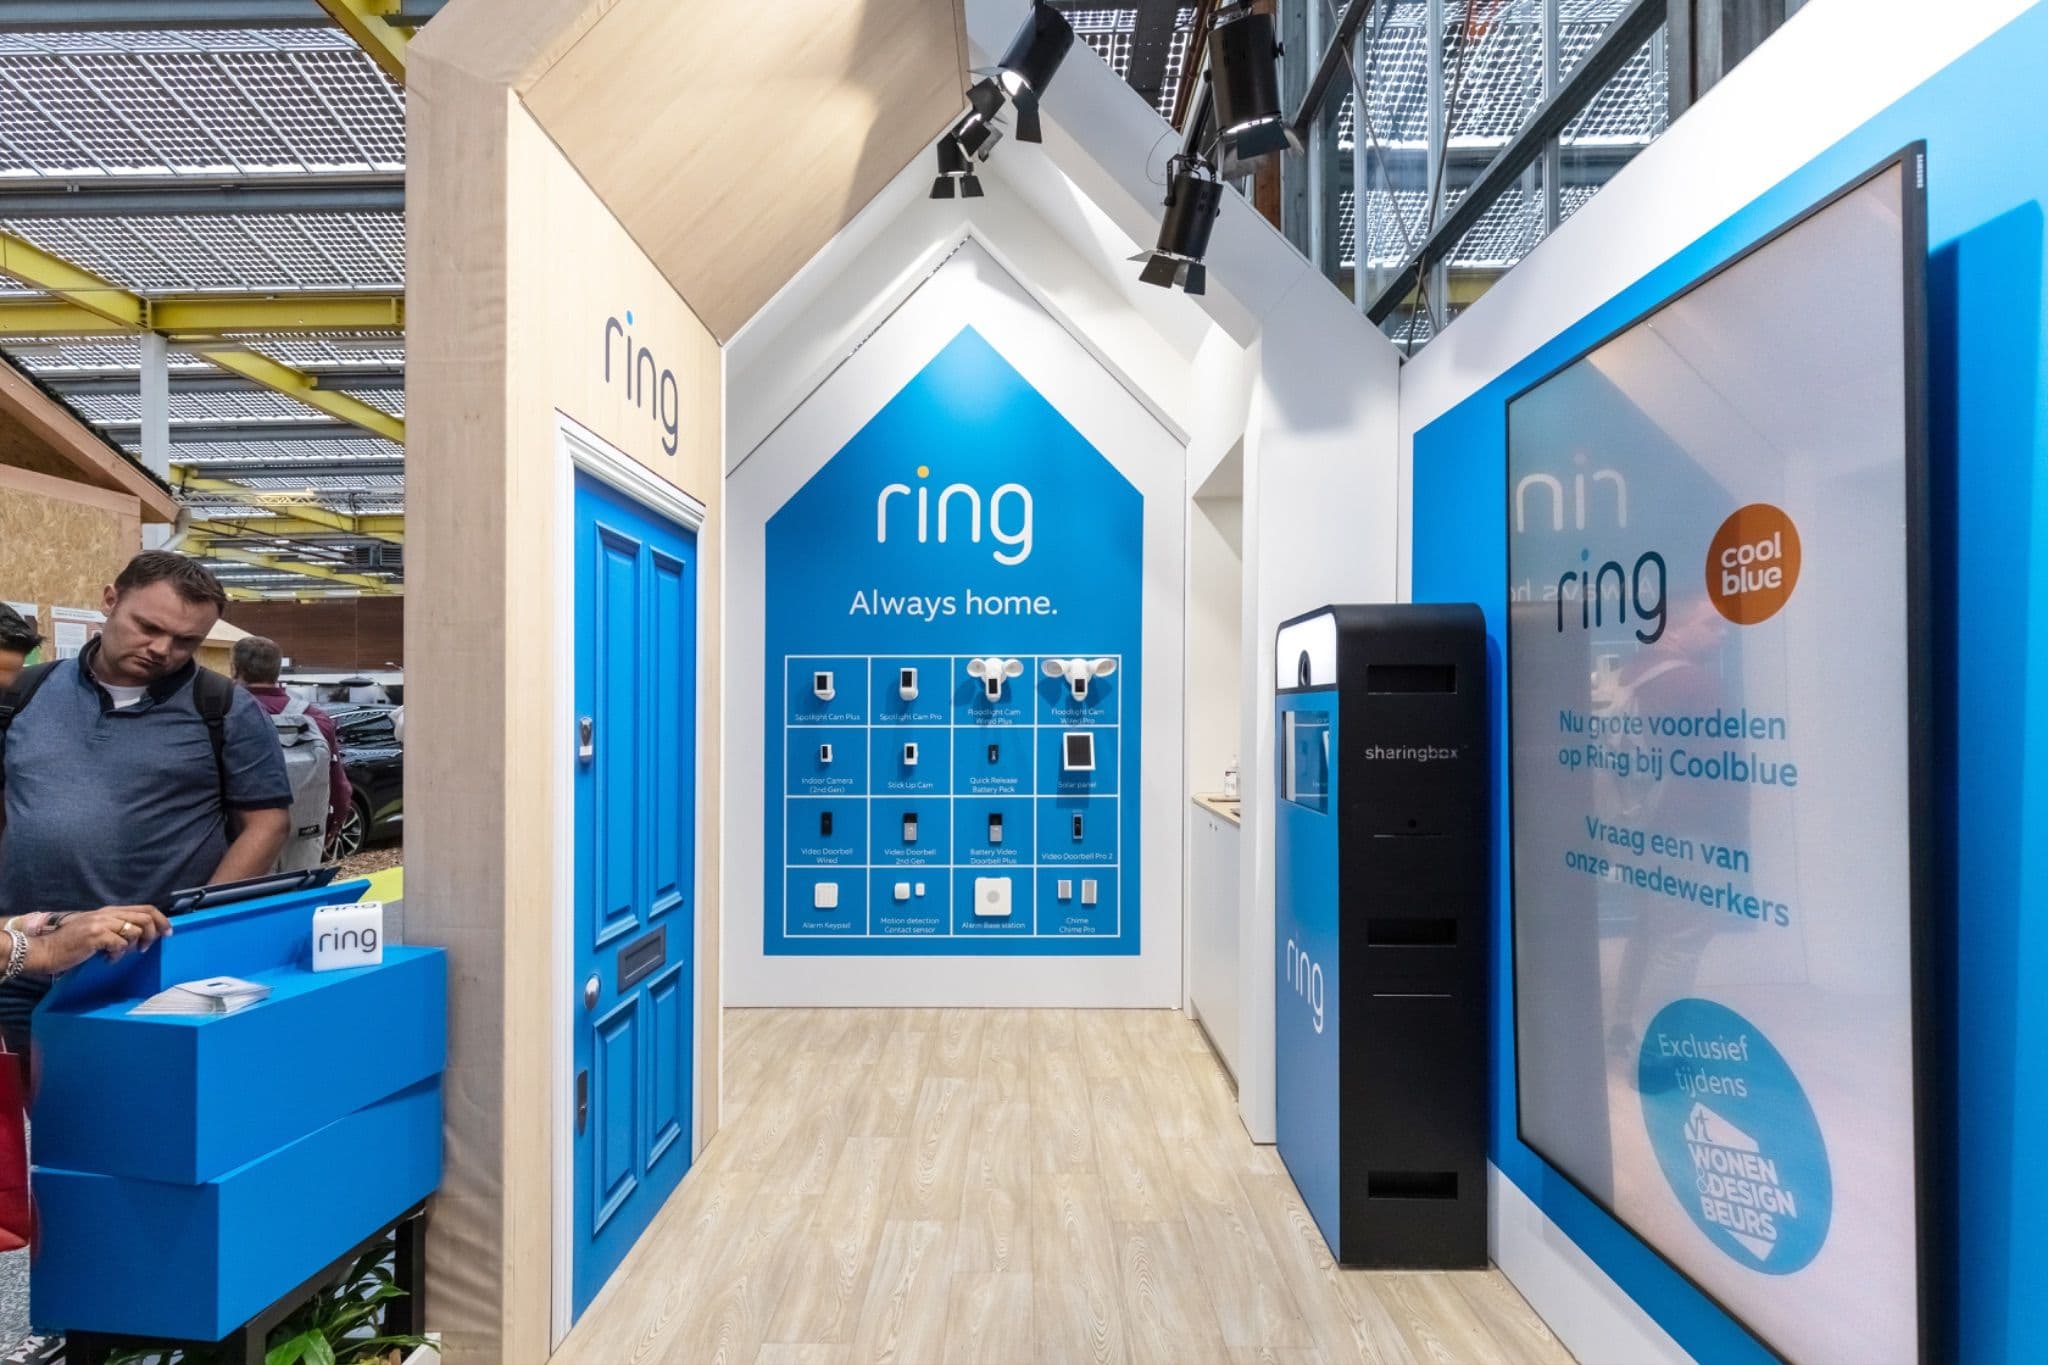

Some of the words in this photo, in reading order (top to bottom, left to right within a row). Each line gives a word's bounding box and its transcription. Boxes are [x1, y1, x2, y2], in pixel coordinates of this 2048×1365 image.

[605, 310, 678, 457] ring
[877, 465, 1033, 566] ring
[1720, 531, 1782, 568] cool
[1558, 548, 1667, 644] ring
[1721, 566, 1783, 597] blue
[849, 588, 957, 622] Always
[966, 588, 1058, 615] home.
[1559, 710, 1584, 733] Nu
[1588, 711, 1643, 739] grote
[1649, 708, 1786, 740] voordelen
[1365, 745, 1458, 762] sharingbox
[1558, 747, 1582, 772] op
[1587, 744, 1630, 777] Ring
[1636, 746, 1663, 781] bij
[1669, 749, 1798, 787] Coolblue
[1585, 815, 1645, 856] Vraag
[1651, 834, 1693, 861] een
[1700, 842, 1749, 873] van
[1565, 851, 1610, 877] onze
[1614, 862, 1790, 927] medewerkers
[319, 927, 377, 953] ring
[1287, 936, 1324, 1035] ring
[1657, 1033, 1749, 1062] Exclusief
[1675, 1067, 1748, 1099] tijdens
[1687, 1143, 1779, 1186] WONEN
[1701, 1196, 1778, 1241] BEURS
